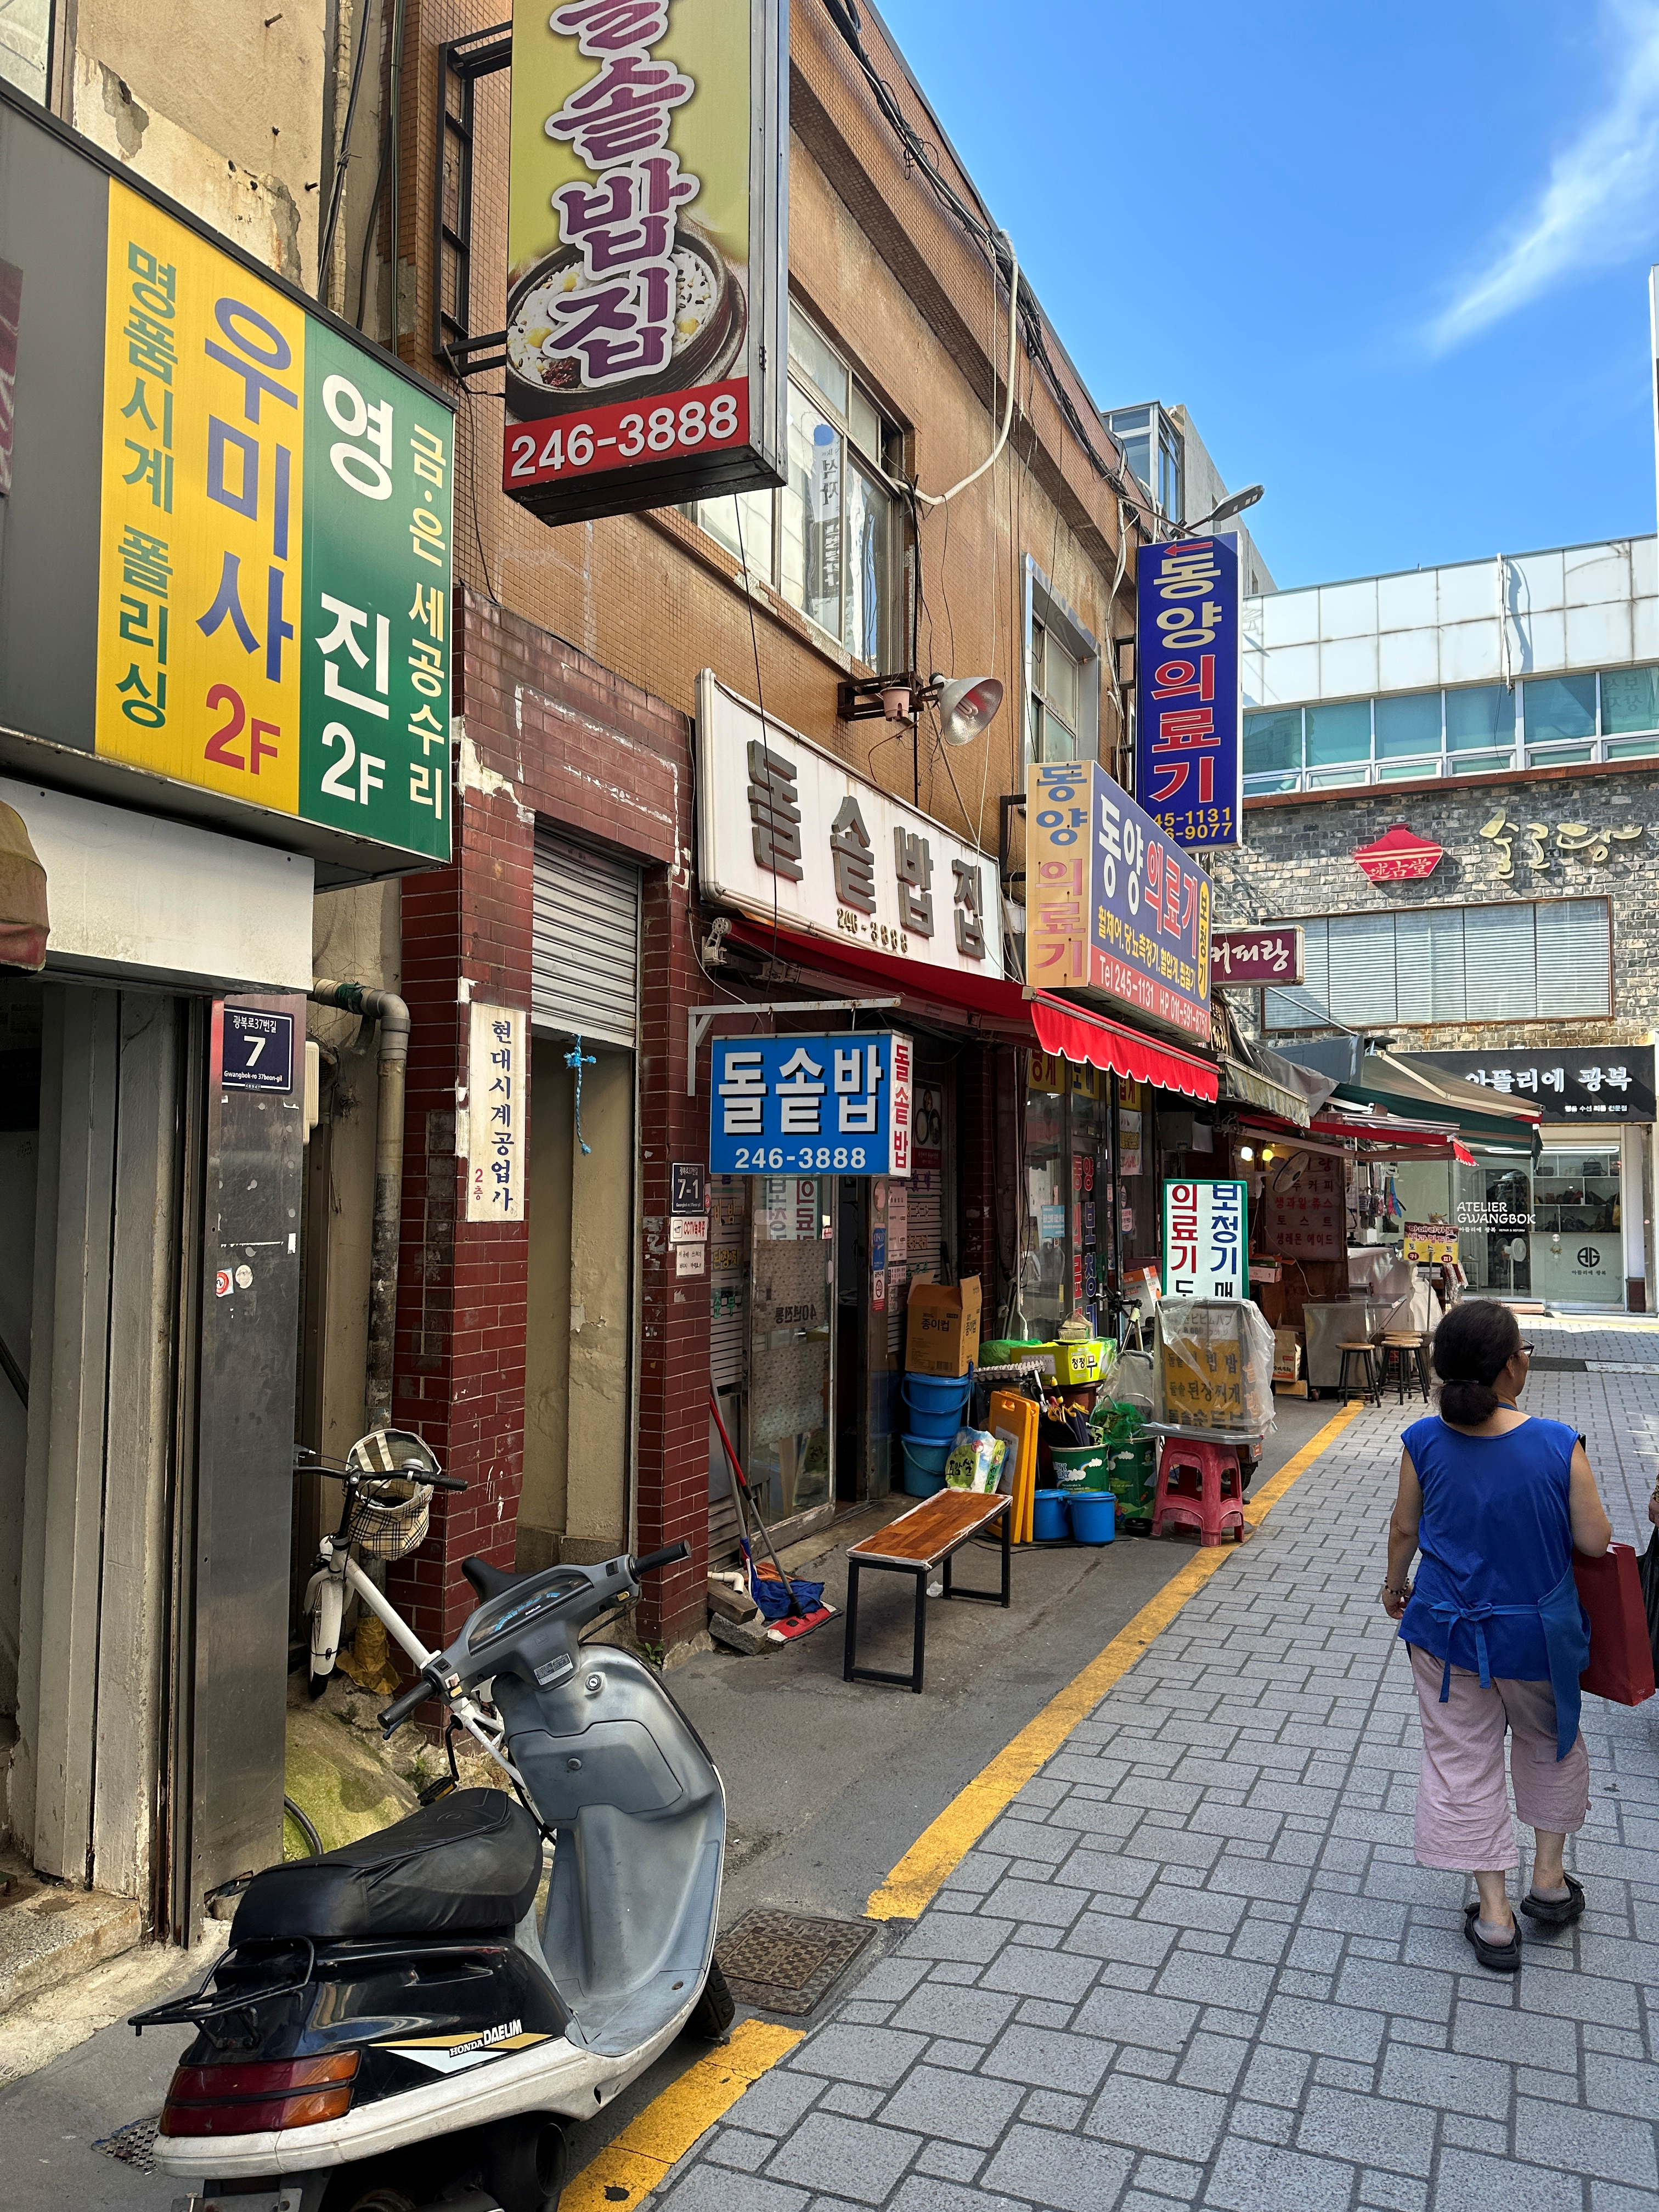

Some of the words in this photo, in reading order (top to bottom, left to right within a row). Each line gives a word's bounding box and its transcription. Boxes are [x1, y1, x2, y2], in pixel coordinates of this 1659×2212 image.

[121, 241, 178, 514] 명품시계
[511, 394, 738, 477] 246-3888
[196, 296, 298, 684] 우미사
[314, 374, 394, 721] 영진
[115, 524, 173, 729] 폴리싱
[406, 582, 445, 821] 세공수리
[1148, 552, 1222, 803] 동양의료기
[204, 684, 281, 775] 2F
[320, 722, 386, 805] 2F
[747, 739, 986, 960] 돌솥밥집
[1154, 806, 1231, 827] 45-1131
[1033, 858, 1087, 978] 의료기
[1098, 793, 1198, 960] 동양의료기
[837, 907, 909, 953] 246-3888
[1198, 889, 1208, 994] 보청기
[1099, 955, 1113, 989] Tel
[1115, 963, 1154, 1009] 245-1131
[233, 1015, 276, 1033] 광복로37번길
[244, 1035, 266, 1066] 7
[224, 1070, 257, 1080] Gwangbok-ro
[488, 1020, 515, 1212] 현대시계공업사
[718, 1045, 882, 1134] 돌솥밥
[894, 1044, 910, 1169] 돌솥밥
[1577, 1066, 1633, 1092] 광복
[473, 1168, 484, 1200] 2층
[678, 1178, 698, 1199] 7-1
[735, 1146, 867, 1170] 246-3888
[1171, 1184, 1198, 1274] 의료기
[1210, 1184, 1238, 1275] 보청기
[1457, 1201, 1508, 1212] ATELIER
[1457, 1213, 1536, 1224] GWANGBOK
[921, 1318, 950, 1332] 종이컵
[449, 2039, 484, 2057] HONDA
[483, 2019, 523, 2046] DAELIM
